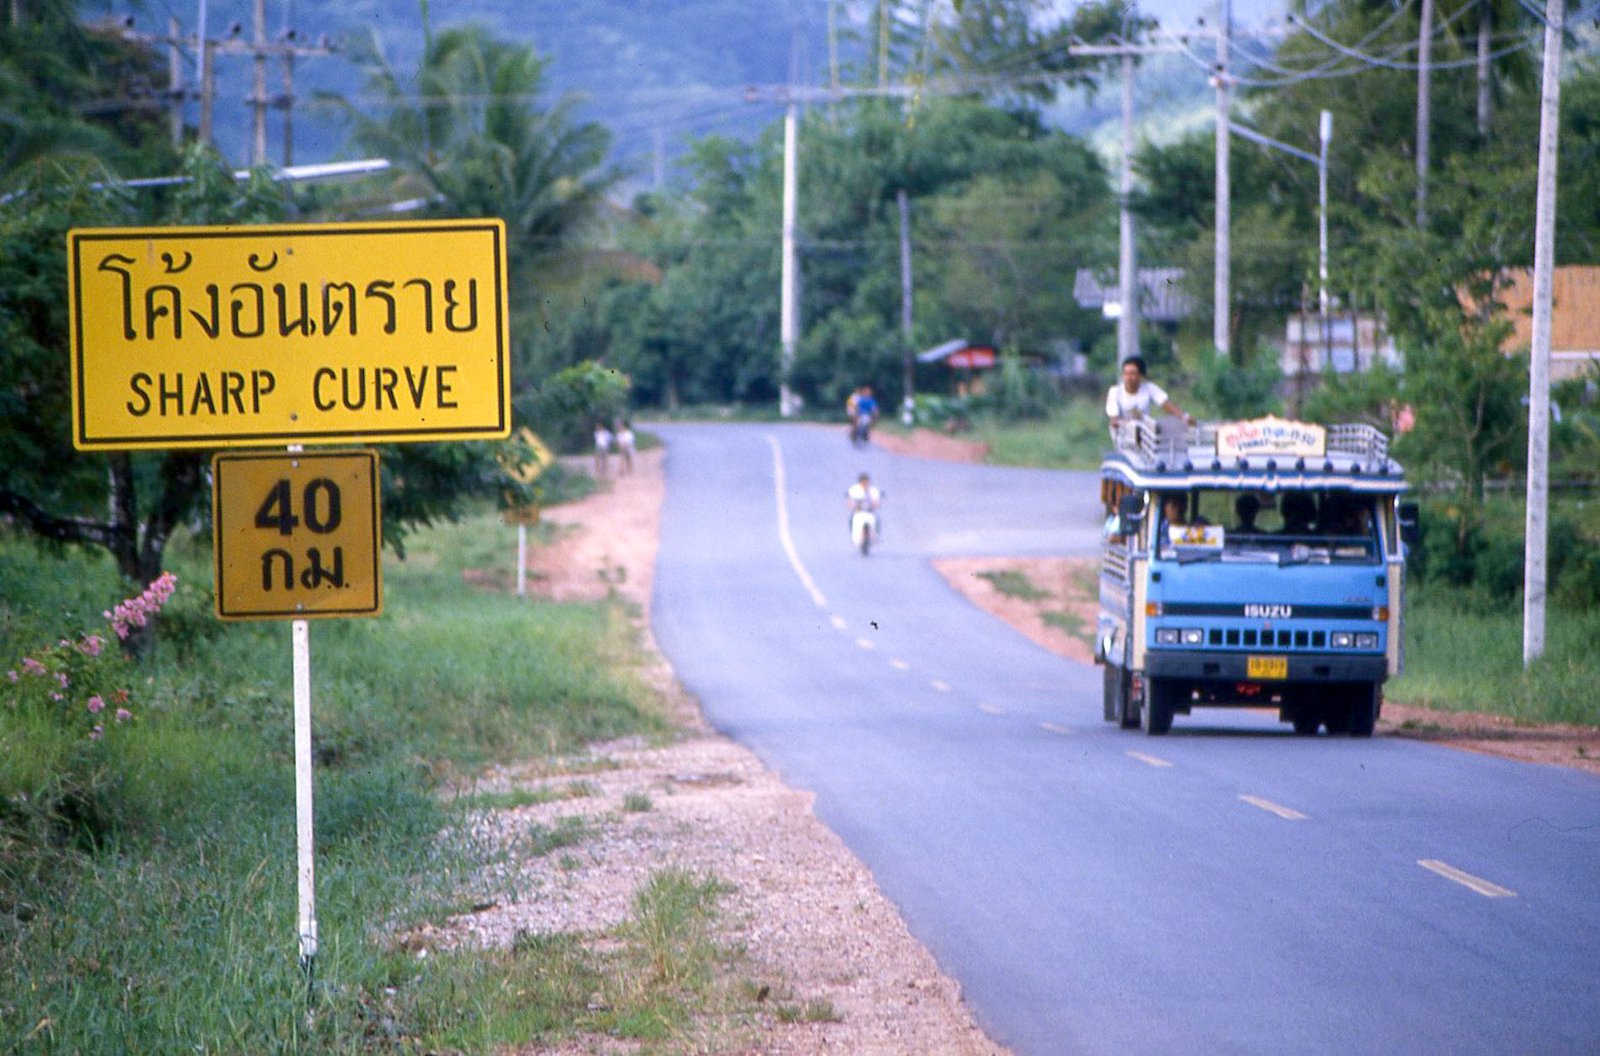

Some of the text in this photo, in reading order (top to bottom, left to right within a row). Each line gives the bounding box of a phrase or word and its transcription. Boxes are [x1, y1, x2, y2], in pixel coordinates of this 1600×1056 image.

[98, 251, 478, 341] โค้งอันตราย
[126, 365, 458, 416] SHARP CURVE
[255, 477, 342, 536] 40
[1244, 604, 1292, 618] ISUZU
